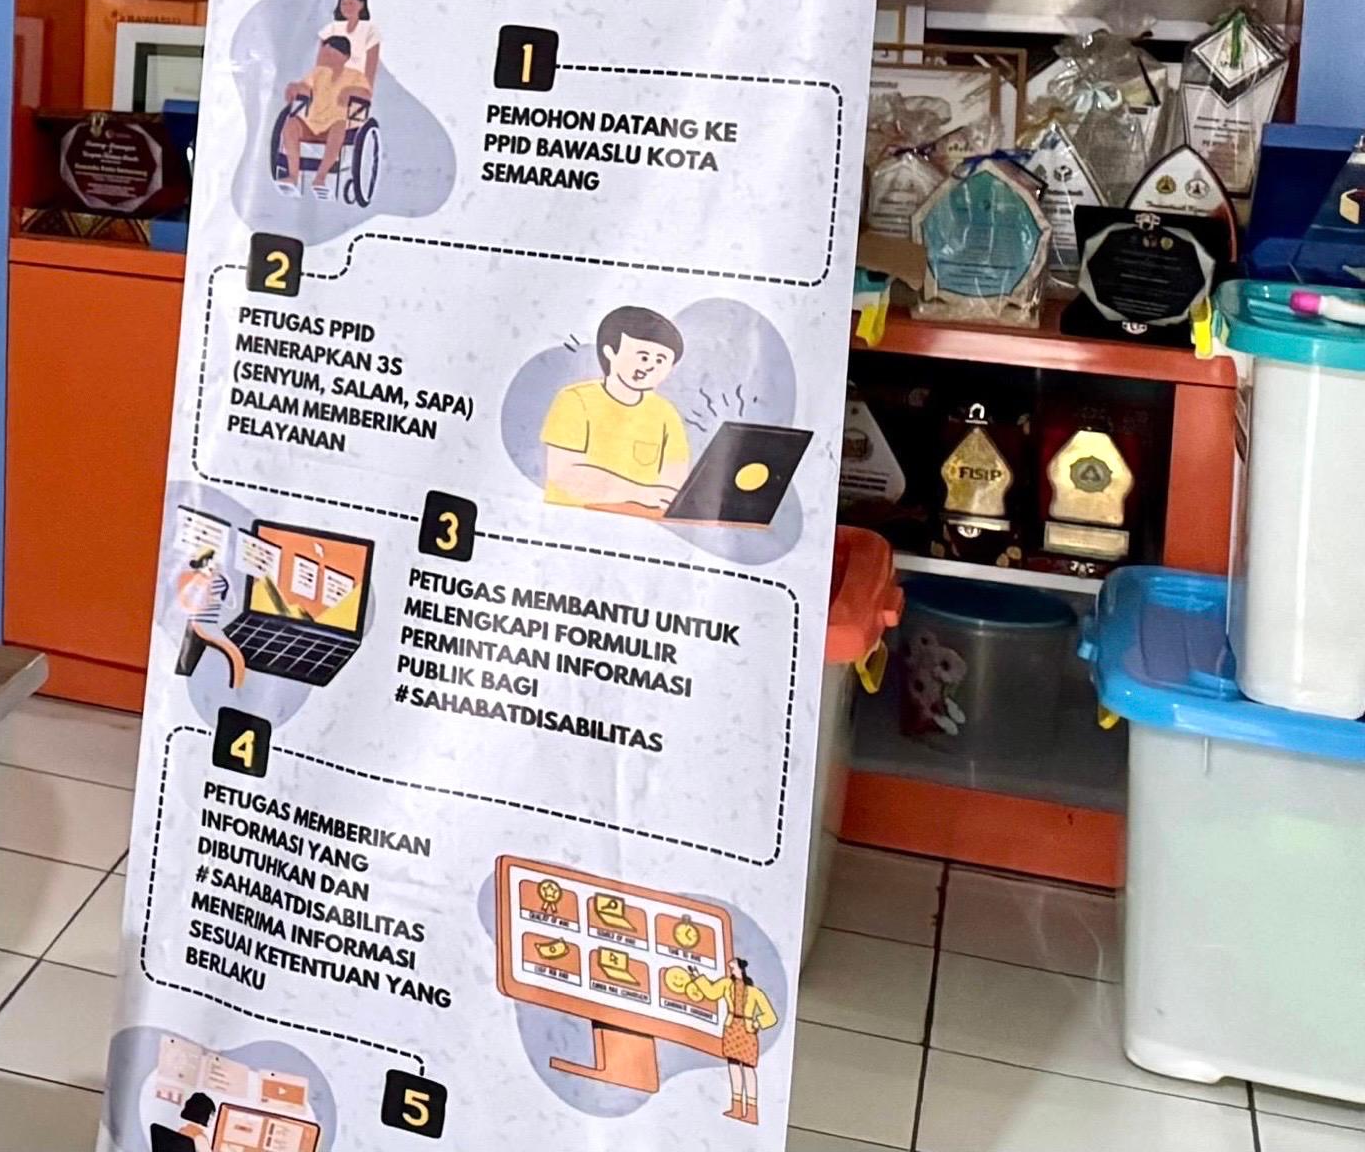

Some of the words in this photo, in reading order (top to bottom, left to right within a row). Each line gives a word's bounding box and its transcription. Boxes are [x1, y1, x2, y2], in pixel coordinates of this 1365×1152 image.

[519, 43, 533, 83] 1
[487, 105, 595, 131] PEMOHON
[600, 113, 698, 139] DATANG
[705, 121, 738, 142] KE
[484, 134, 531, 155] PPID
[536, 138, 641, 164] BAWASLU
[647, 147, 718, 172] KOTA
[481, 162, 600, 190] SEMARANG
[264, 251, 288, 291] 2
[239, 307, 324, 335] PETUGAS
[330, 320, 375, 342] PPID
[236, 334, 372, 371] MENERAPKAN
[377, 355, 403, 376] 3S
[234, 361, 325, 395] (SENYUM,
[332, 377, 409, 409] SALAM,
[416, 390, 474, 421] SAPA)
[227, 414, 346, 452] PELAYANAN
[231, 388, 299, 416] DALAM
[303, 400, 437, 439] MEMBERIKAN
[438, 512, 459, 549] 3
[409, 568, 506, 604] PETUGAS
[512, 588, 649, 628] MEMBANTU
[656, 611, 740, 645] UNTUK
[404, 597, 548, 641] MELENGKAPI
[555, 624, 677, 664] FORMULIR
[397, 654, 475, 687] PUBLIK
[481, 671, 538, 697] BAGI
[401, 626, 550, 670] PERMINTAAN
[556, 654, 692, 697] INFORMASI
[394, 684, 663, 753] #SAHABATDISABILITAS
[230, 731, 254, 767] 4
[203, 781, 290, 820] PETUGAS
[293, 806, 431, 857] MEMBERIKAN
[201, 809, 304, 856] INFORMASI
[309, 840, 368, 873] YANG
[198, 836, 315, 889] DIBUTUHKAN
[320, 874, 369, 901] DAN
[191, 892, 286, 939] MENERIMA
[291, 925, 415, 970] INFORMASI
[185, 946, 266, 990] BERLAKU
[189, 920, 252, 956] SESUAI
[254, 941, 379, 990] KETENTUAN
[386, 973, 451, 1008] YANG
[402, 1088, 429, 1126] 5
